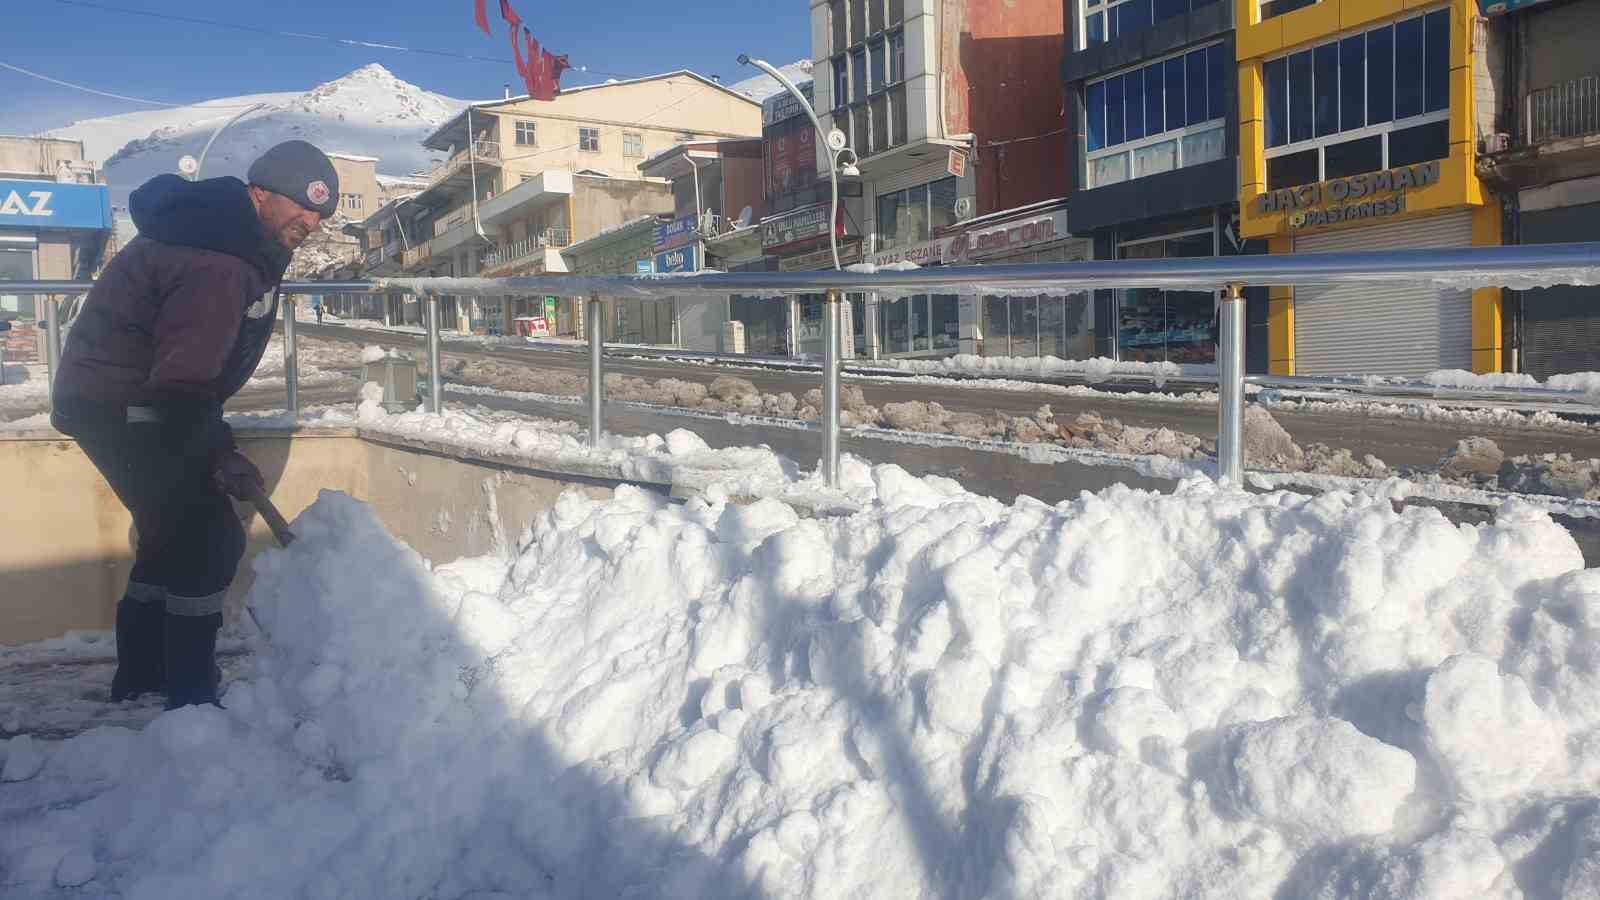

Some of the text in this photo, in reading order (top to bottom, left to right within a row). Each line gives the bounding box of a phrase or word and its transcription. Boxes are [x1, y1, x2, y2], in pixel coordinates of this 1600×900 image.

[1329, 161, 1440, 201] OSMAN
[0, 190, 53, 216] AZ
[1304, 191, 1404, 227] PASTANESİ
